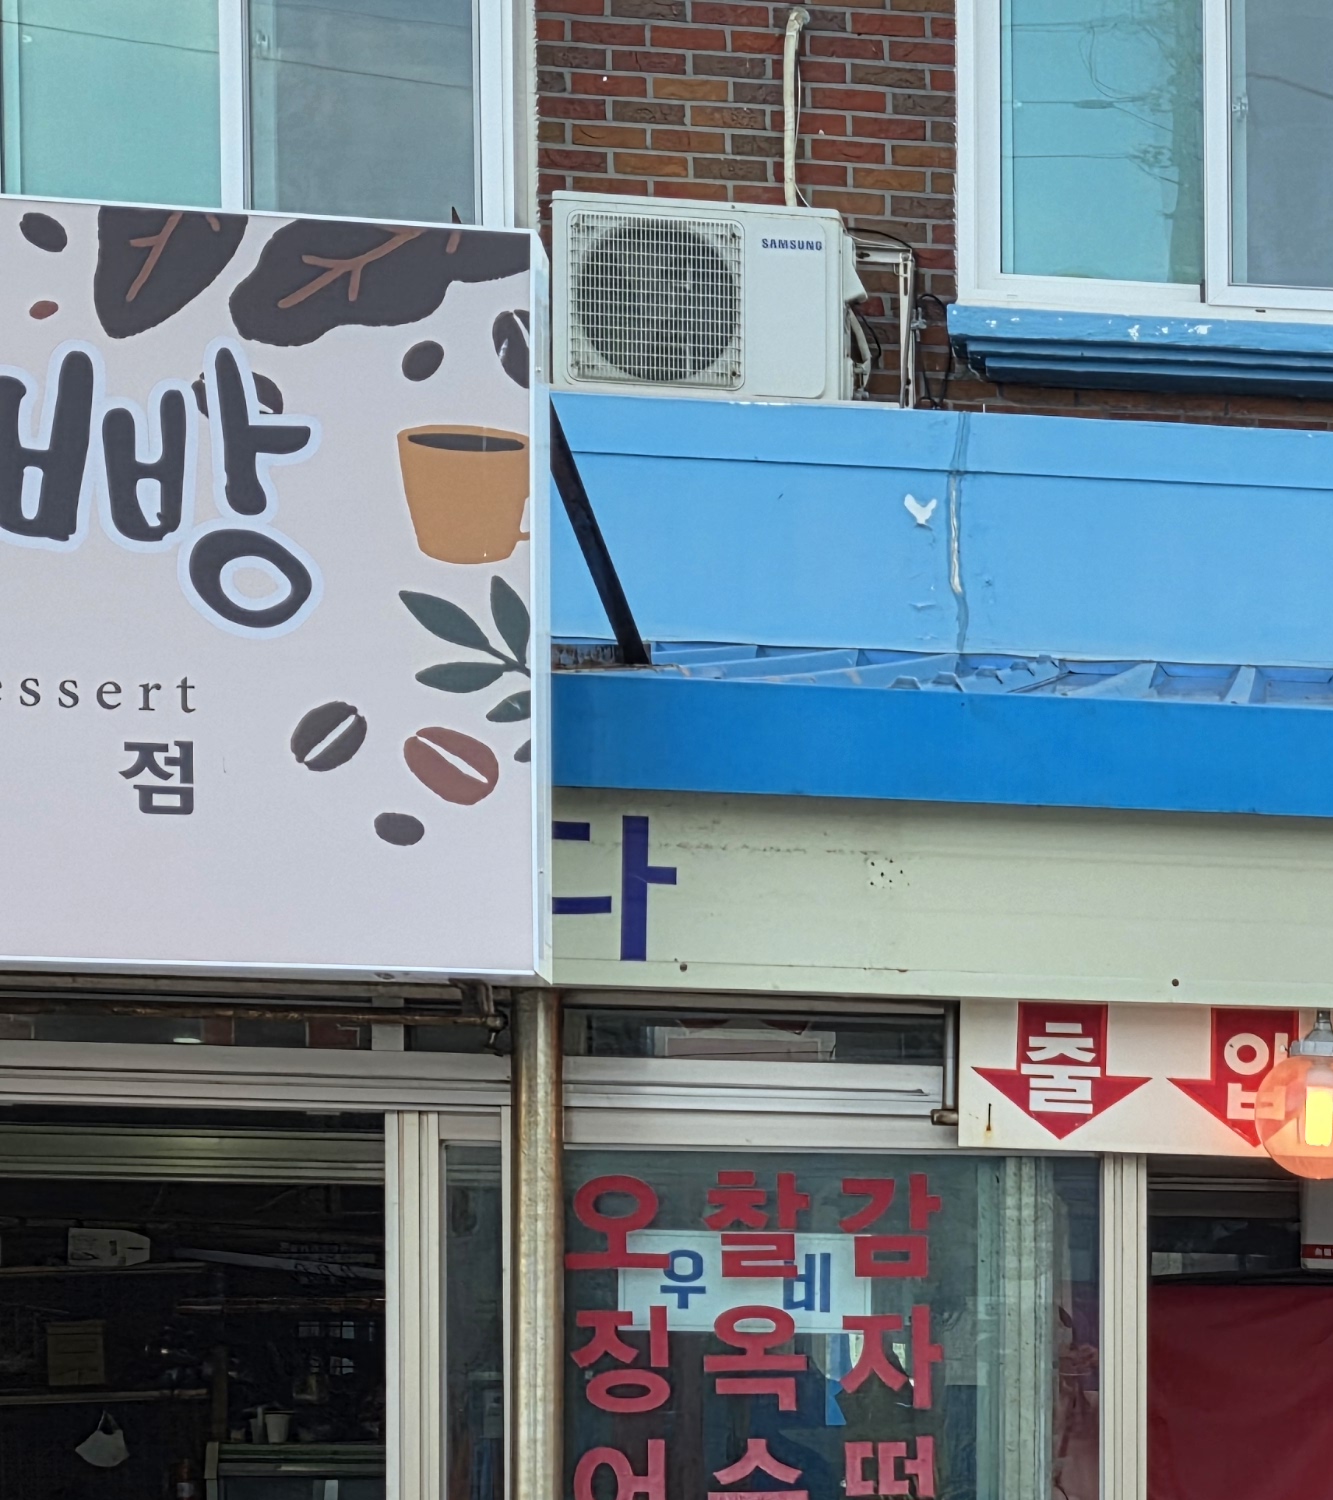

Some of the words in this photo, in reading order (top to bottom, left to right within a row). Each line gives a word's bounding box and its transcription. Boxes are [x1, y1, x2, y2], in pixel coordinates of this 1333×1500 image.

[761, 238, 823, 251] SAMSUNG
[0, 676, 196, 713] ssert
[120, 740, 195, 816] 점
